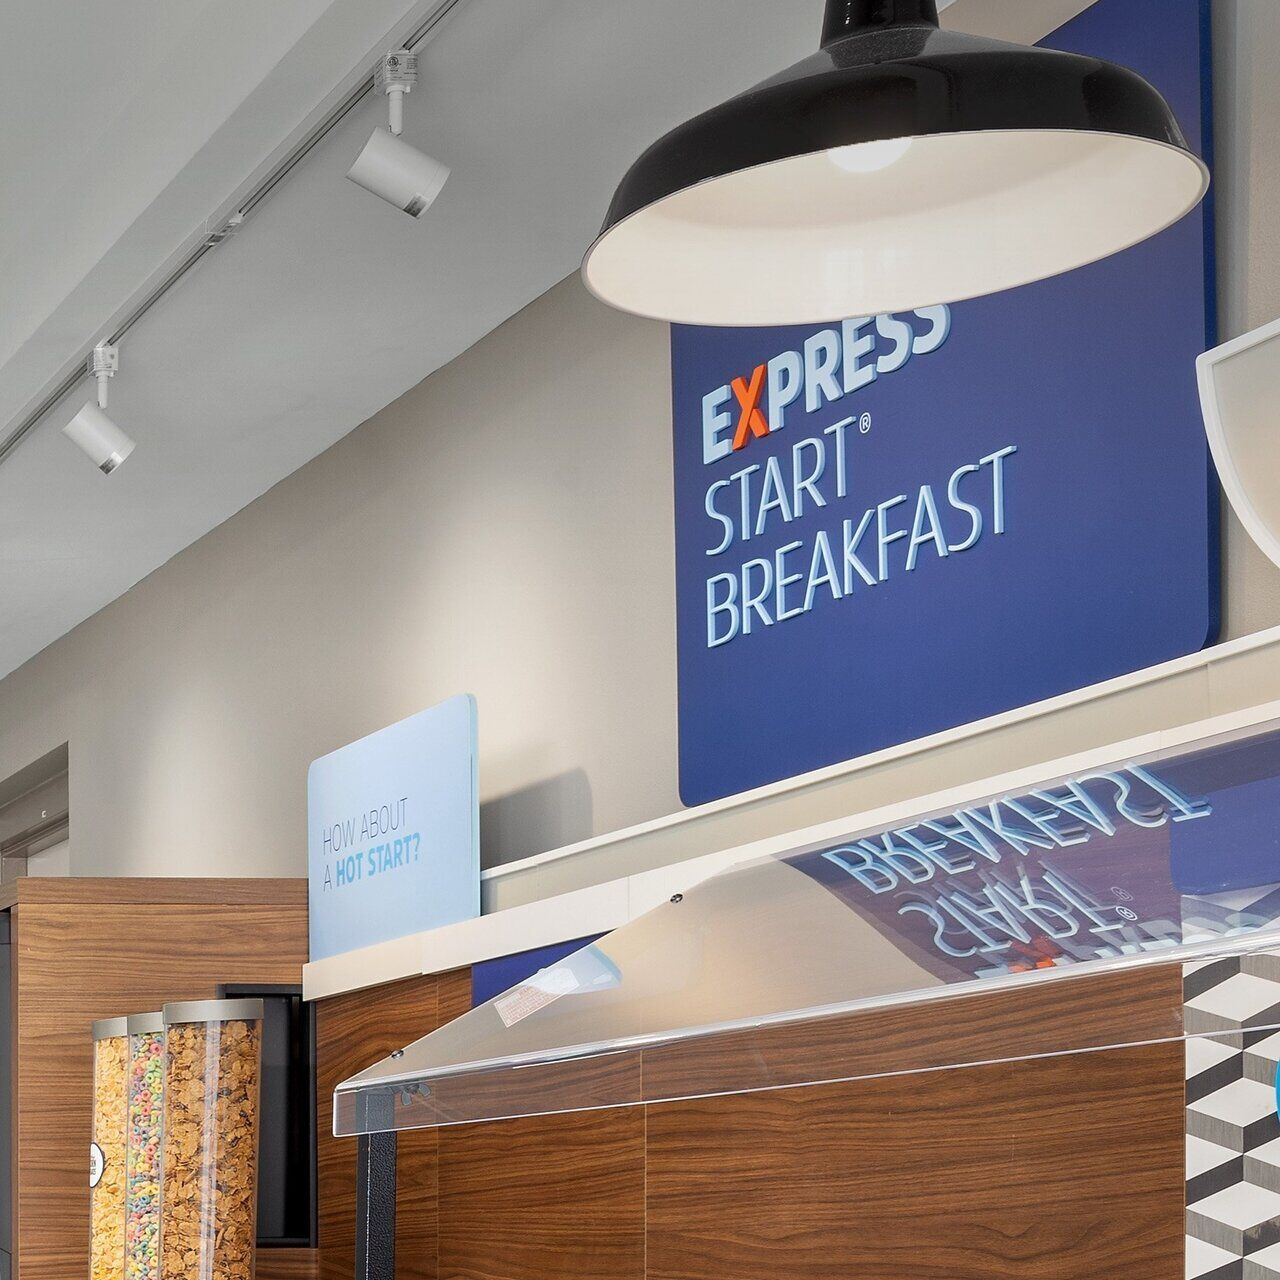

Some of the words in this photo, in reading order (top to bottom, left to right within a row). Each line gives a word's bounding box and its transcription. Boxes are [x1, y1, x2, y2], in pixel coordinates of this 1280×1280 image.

[702, 303, 951, 465] EXPRESS
[706, 445, 1017, 648] BREAKFAST
[323, 817, 355, 855] HOW
[360, 797, 408, 841] ABOUT
[323, 864, 332, 892] A
[336, 852, 363, 887] HOT
[368, 832, 421, 876] START?
